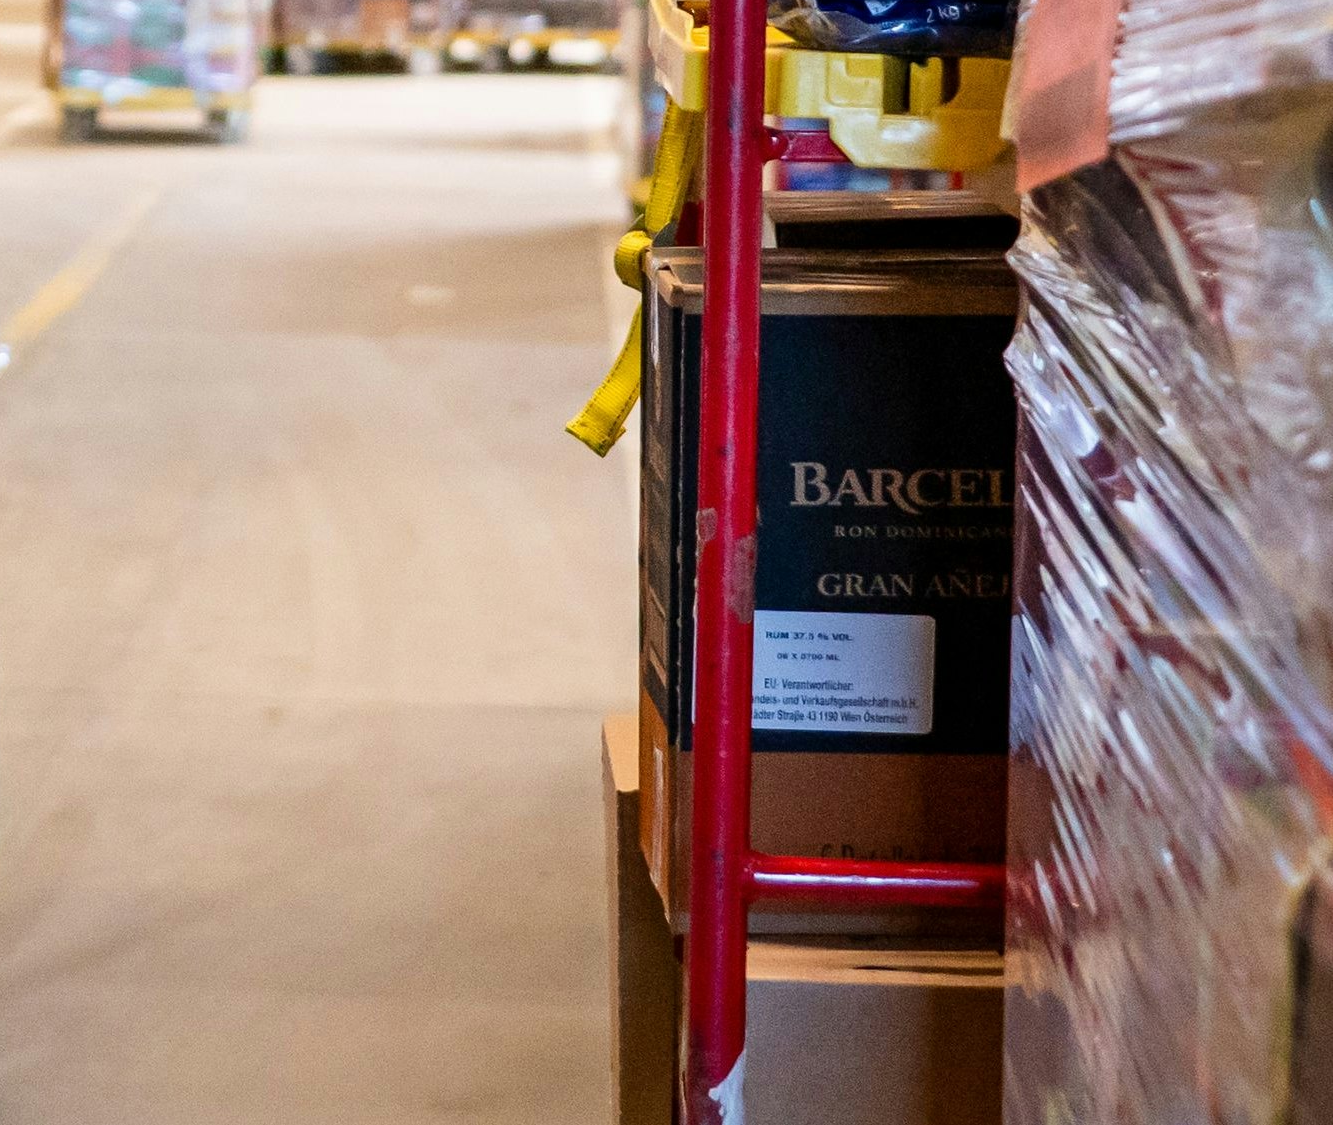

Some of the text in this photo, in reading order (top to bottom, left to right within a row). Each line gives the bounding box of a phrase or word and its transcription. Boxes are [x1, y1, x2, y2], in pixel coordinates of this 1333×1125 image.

[926, 5, 960, 23] 2 kg
[790, 461, 1014, 515] BARCEL
[835, 525, 1014, 539] RON DOMINICAN
[817, 567, 1009, 597] GRAN AÑEJ
[765, 631, 789, 639] RUM
[782, 695, 799, 705] und
